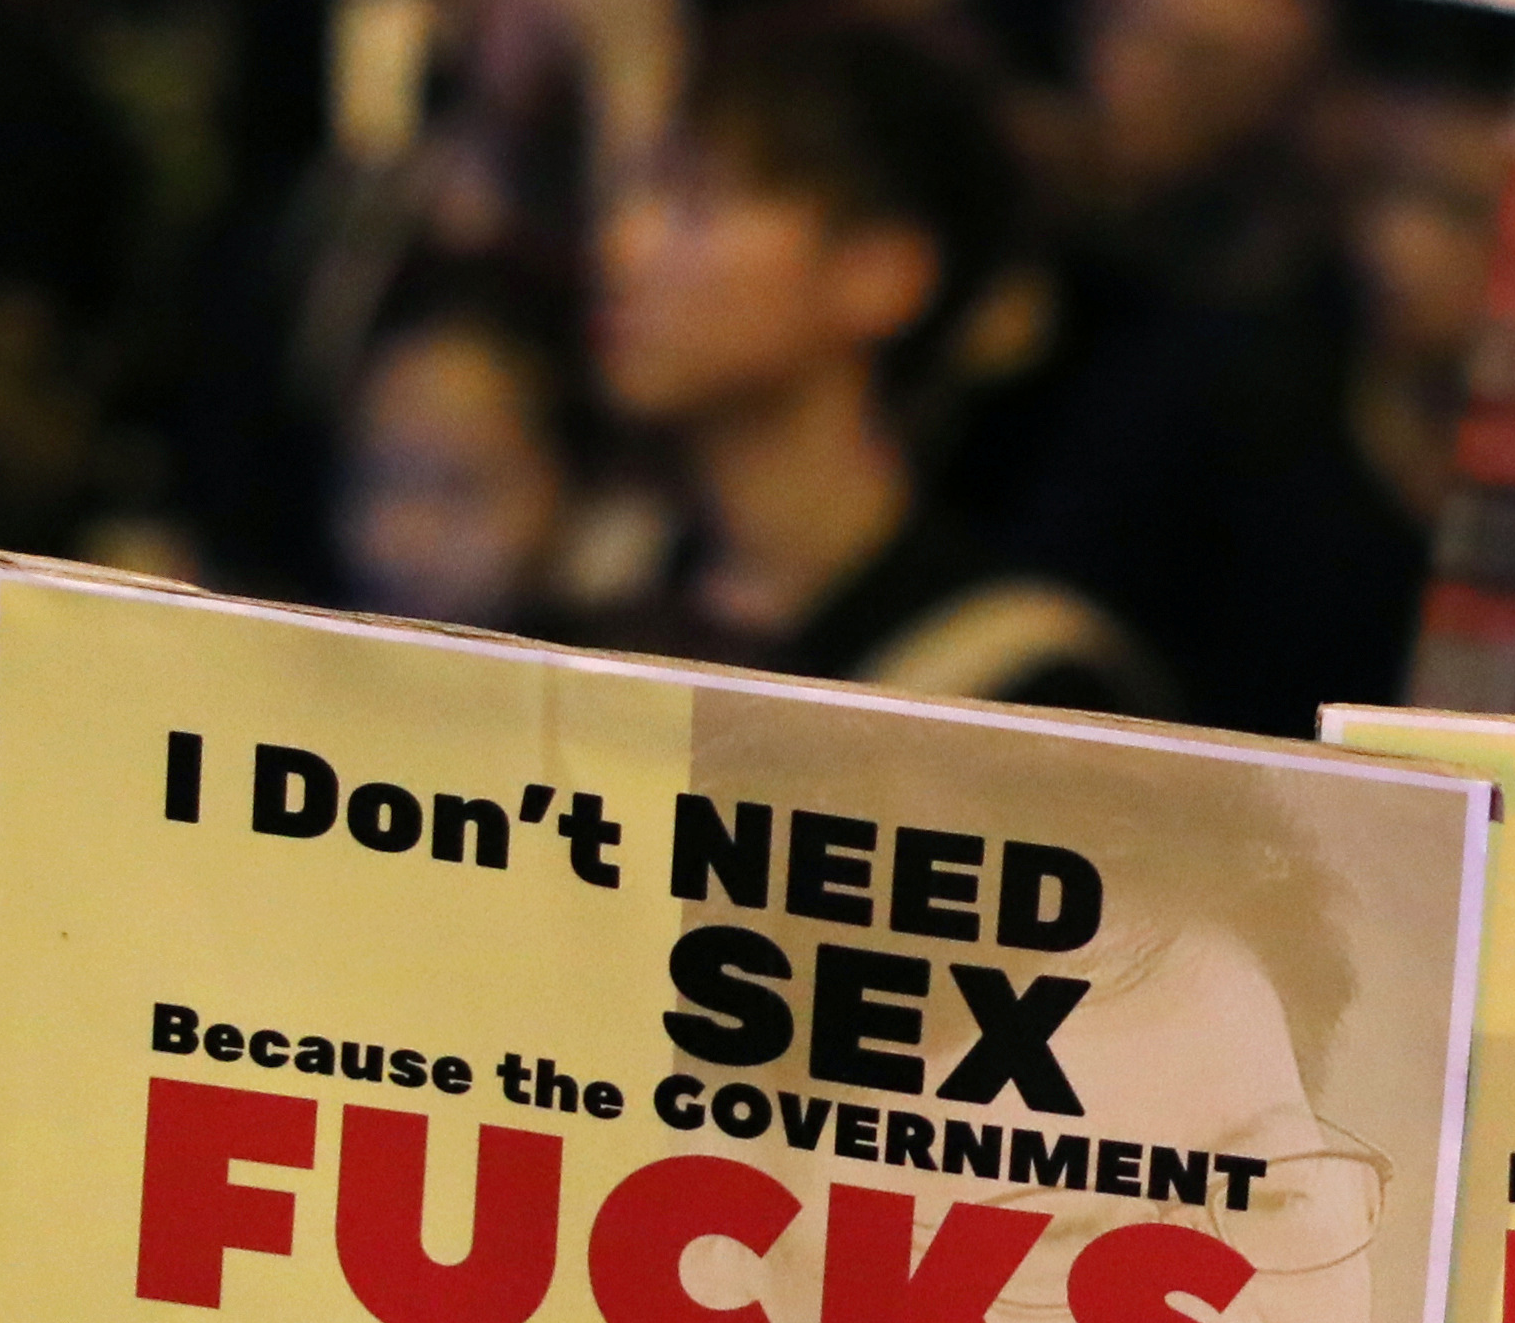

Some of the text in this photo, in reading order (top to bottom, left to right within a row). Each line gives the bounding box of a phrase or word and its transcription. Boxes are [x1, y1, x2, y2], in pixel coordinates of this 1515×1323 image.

[166, 732, 1102, 952] I Don't NEED
[153, 1004, 1266, 1210] Because the GOVERNMENT
[664, 926, 1090, 1116] SEX
